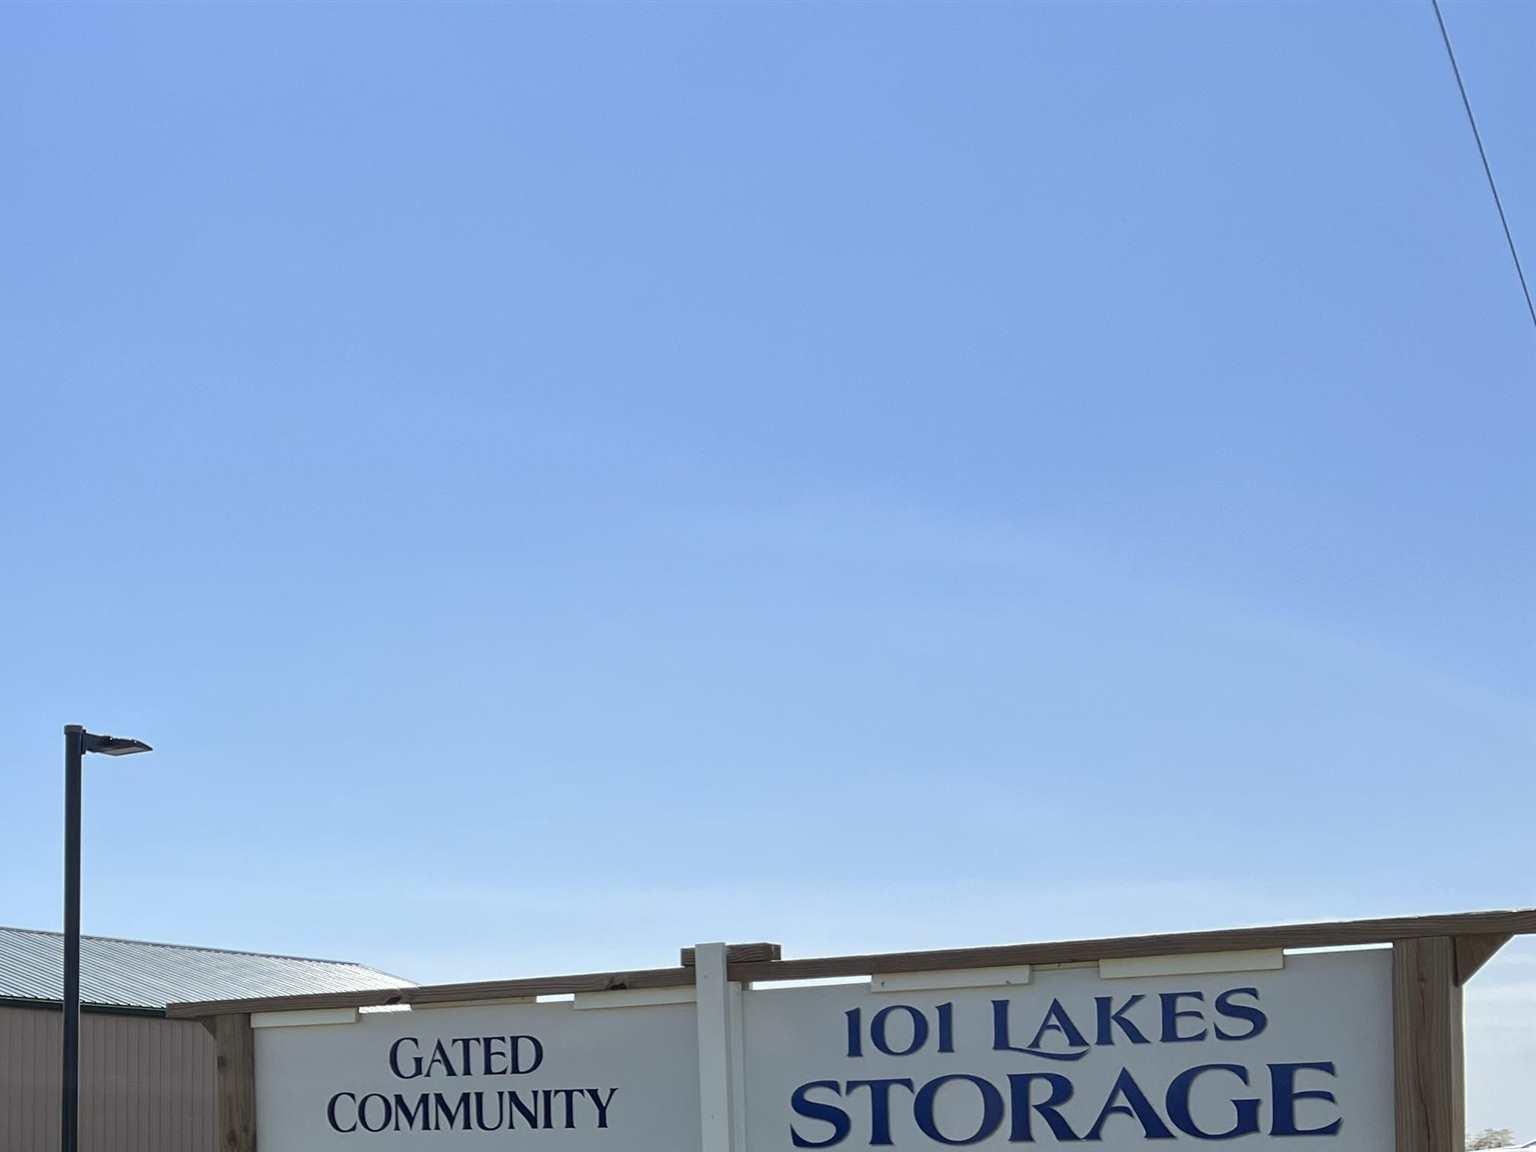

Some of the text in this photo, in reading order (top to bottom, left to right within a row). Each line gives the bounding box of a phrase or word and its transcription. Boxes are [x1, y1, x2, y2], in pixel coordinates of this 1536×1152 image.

[845, 987, 1268, 1062] 101 LAKES
[389, 1034, 544, 1080] GATED
[327, 1087, 619, 1133] COMMUNITY
[789, 1061, 1343, 1149] STORAGE
